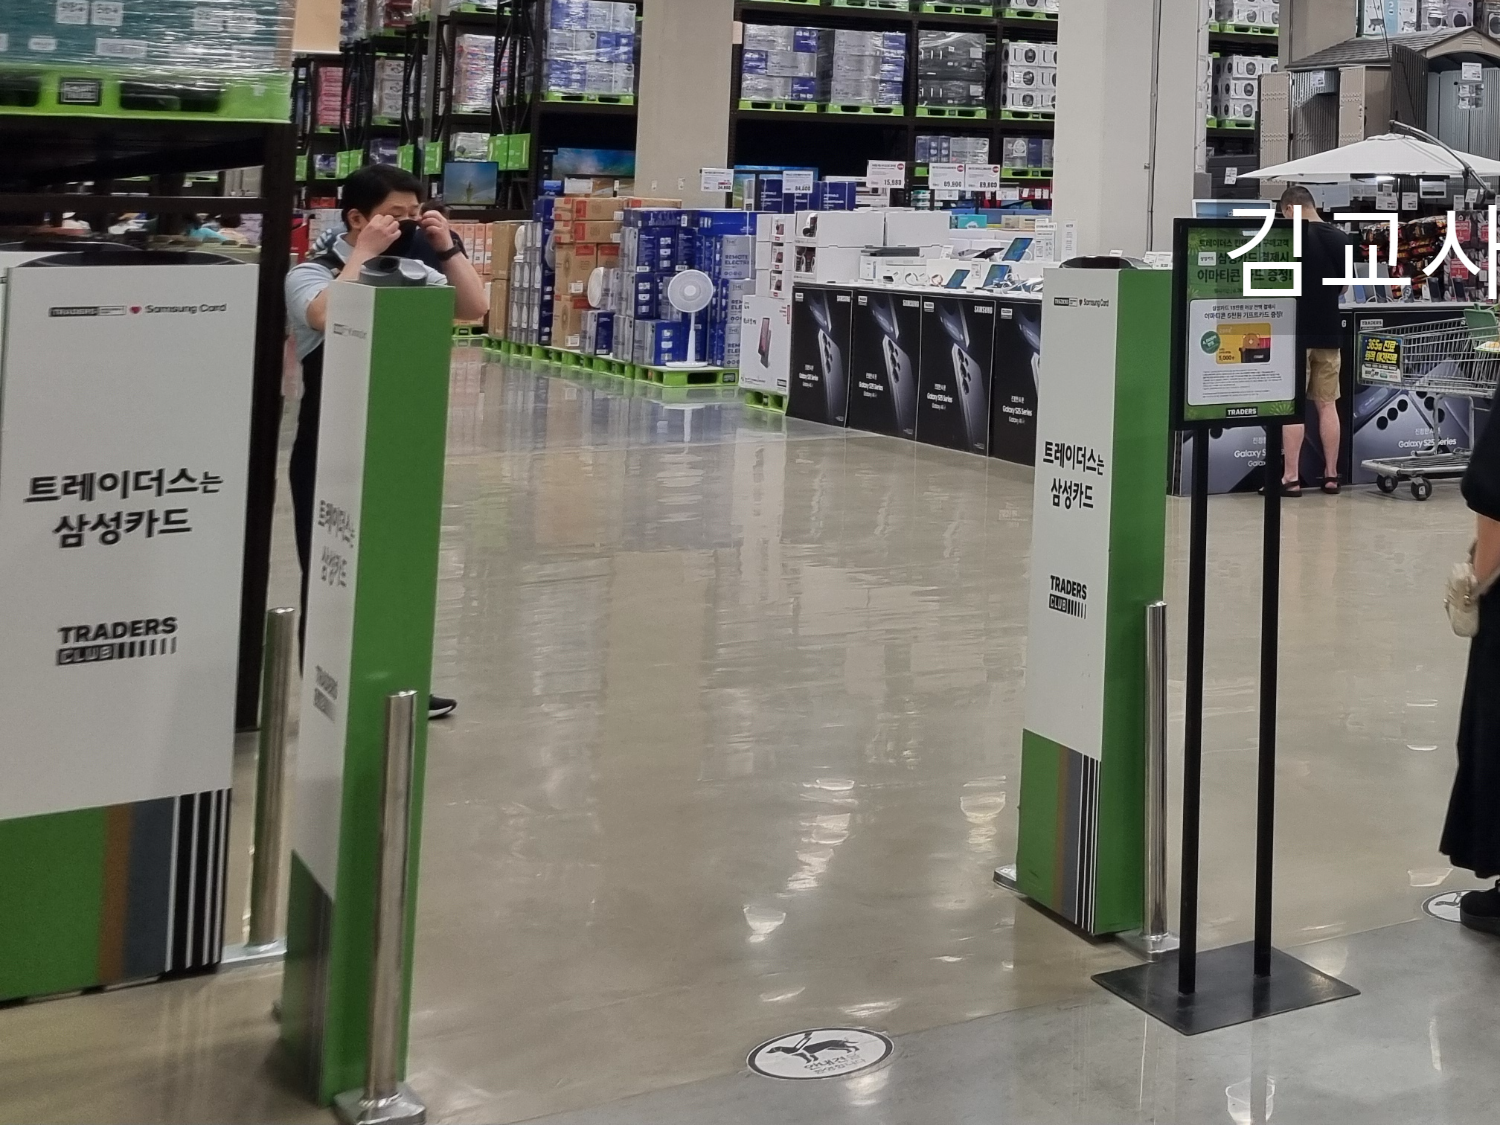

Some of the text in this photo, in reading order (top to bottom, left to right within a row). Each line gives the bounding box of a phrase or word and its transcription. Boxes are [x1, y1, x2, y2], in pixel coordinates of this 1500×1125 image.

[1263, 239, 1290, 248] 구매고객
[1197, 268, 1240, 283] 이마티콘
[145, 303, 227, 314] Samsung Card
[1234, 449, 1261, 459] Galaxy
[1398, 440, 1422, 449] Galaxy
[1042, 440, 1105, 476] 트레이더스는
[23, 468, 224, 503] 트레이더스는
[1050, 478, 1094, 510] 삼성카드
[53, 507, 193, 549] 삼성카드
[1050, 574, 1088, 601] TRADERS
[1050, 595, 1067, 612] CLUB
[58, 616, 179, 645] TRADERS
[61, 645, 112, 664] CLUB
